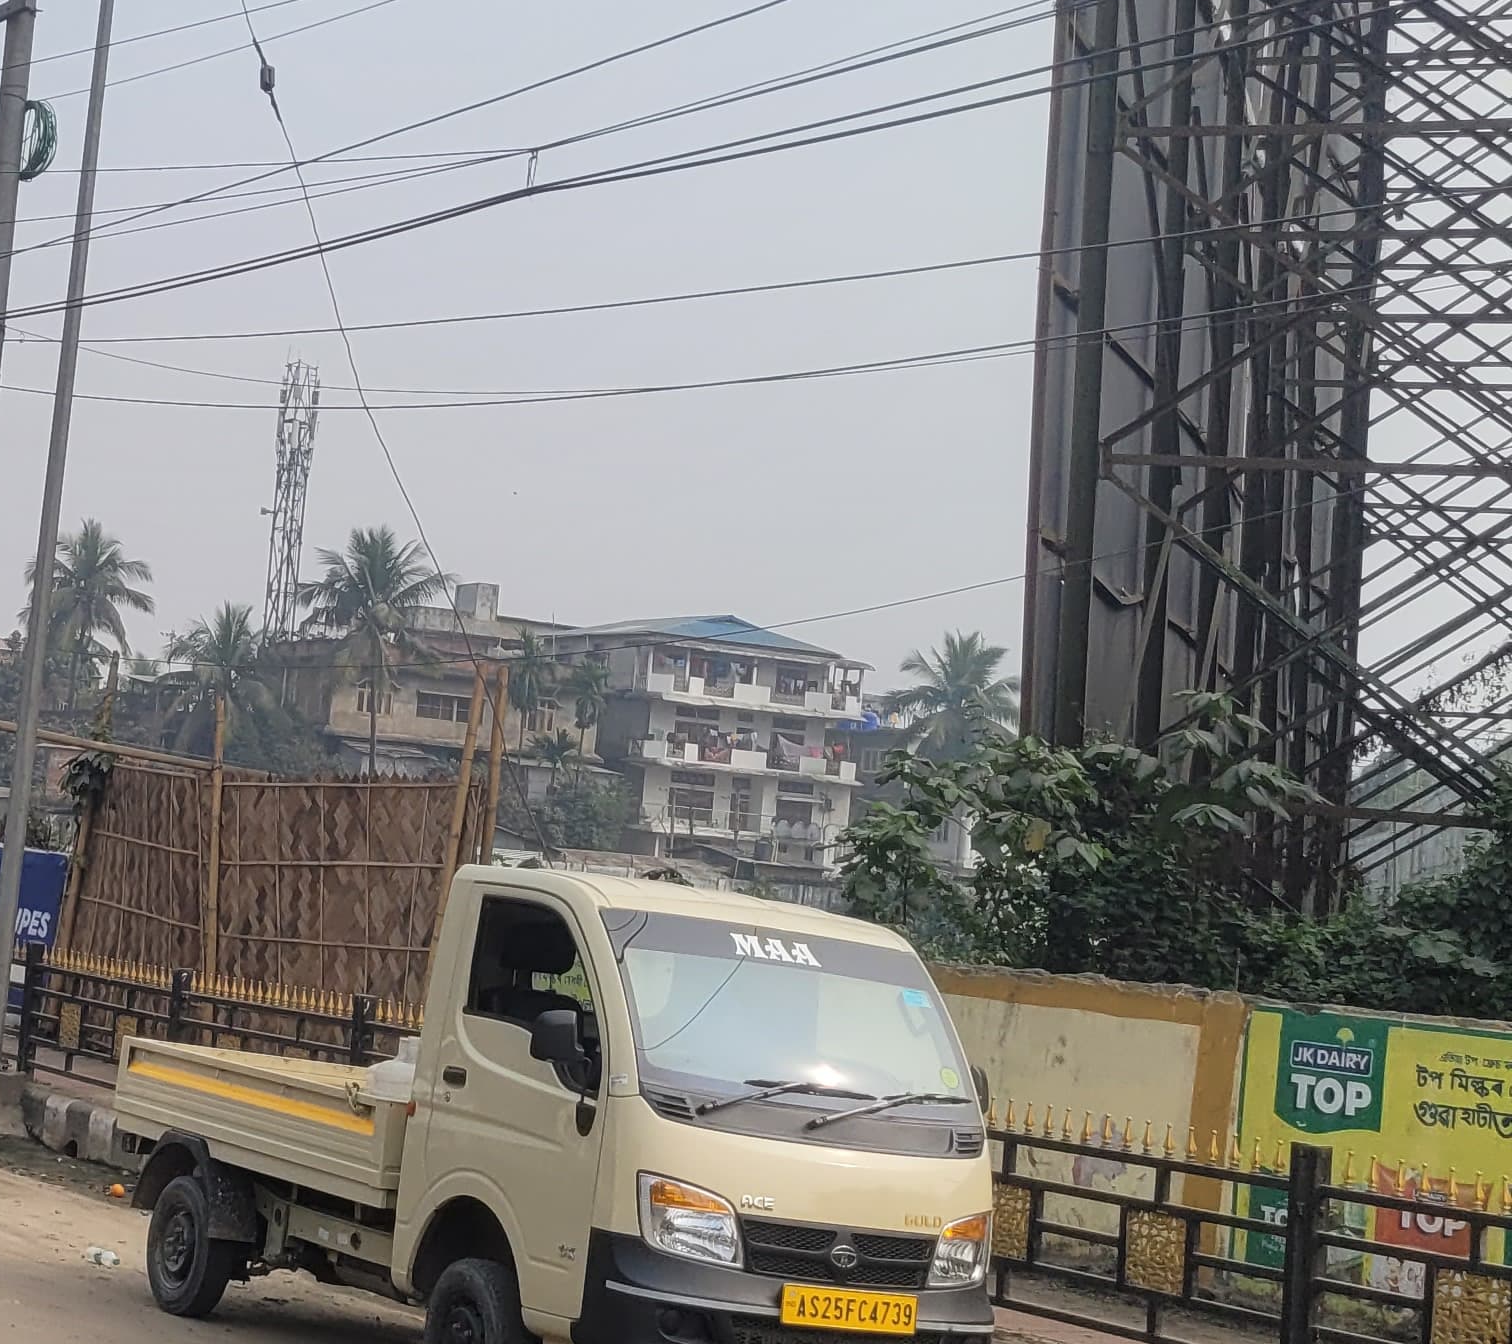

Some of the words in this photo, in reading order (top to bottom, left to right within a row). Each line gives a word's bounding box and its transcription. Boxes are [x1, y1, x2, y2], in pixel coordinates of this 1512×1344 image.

[14, 907, 51, 938] IPES
[729, 932, 822, 968] MAA
[1316, 1049, 1369, 1070] DAIRY
[1416, 1064, 1445, 1090] টপ
[1291, 1073, 1372, 1116] TOP
[741, 1194, 775, 1211] ACE
[1260, 1205, 1288, 1226] TO
[796, 1294, 913, 1327] AS25FC4739
